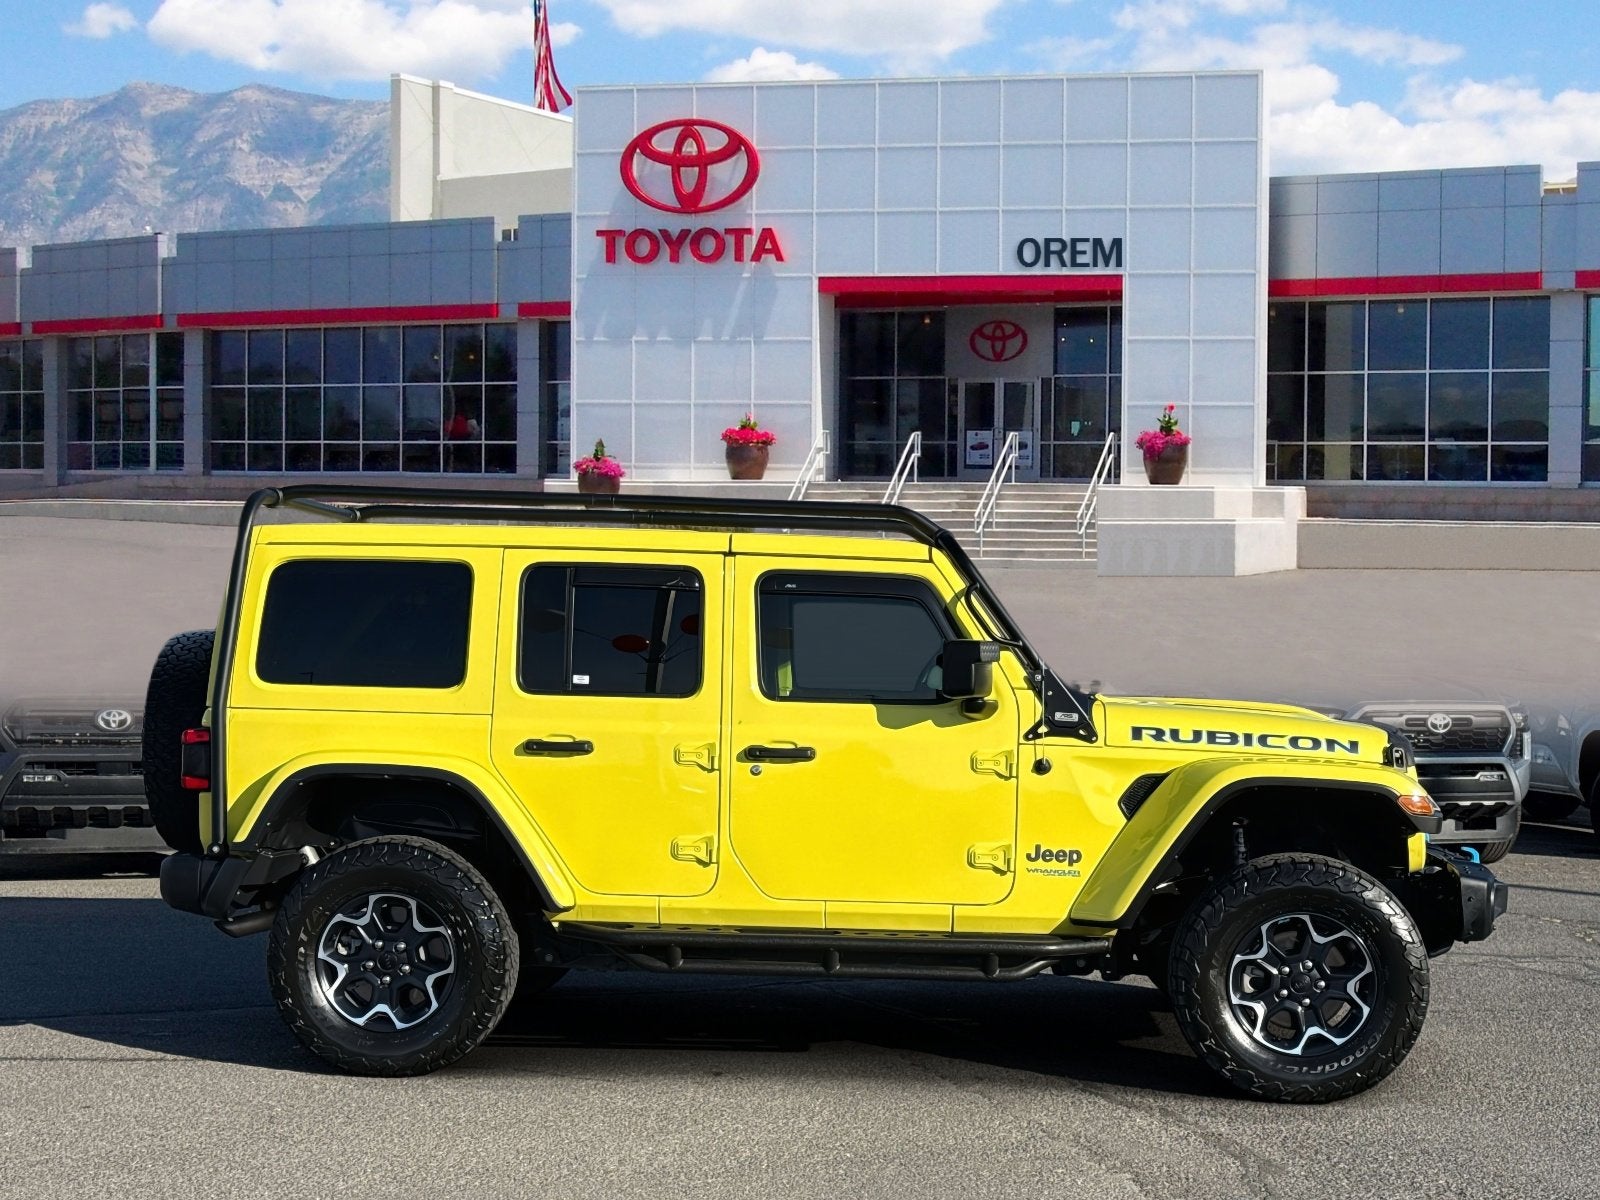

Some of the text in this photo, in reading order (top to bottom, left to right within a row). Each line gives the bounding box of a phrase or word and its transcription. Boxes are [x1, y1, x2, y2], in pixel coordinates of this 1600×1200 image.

[596, 228, 784, 264] TOYOTA
[1017, 238, 1122, 267] OREM
[1131, 726, 1359, 754] RUBICON
[1026, 844, 1082, 867] Jeep
